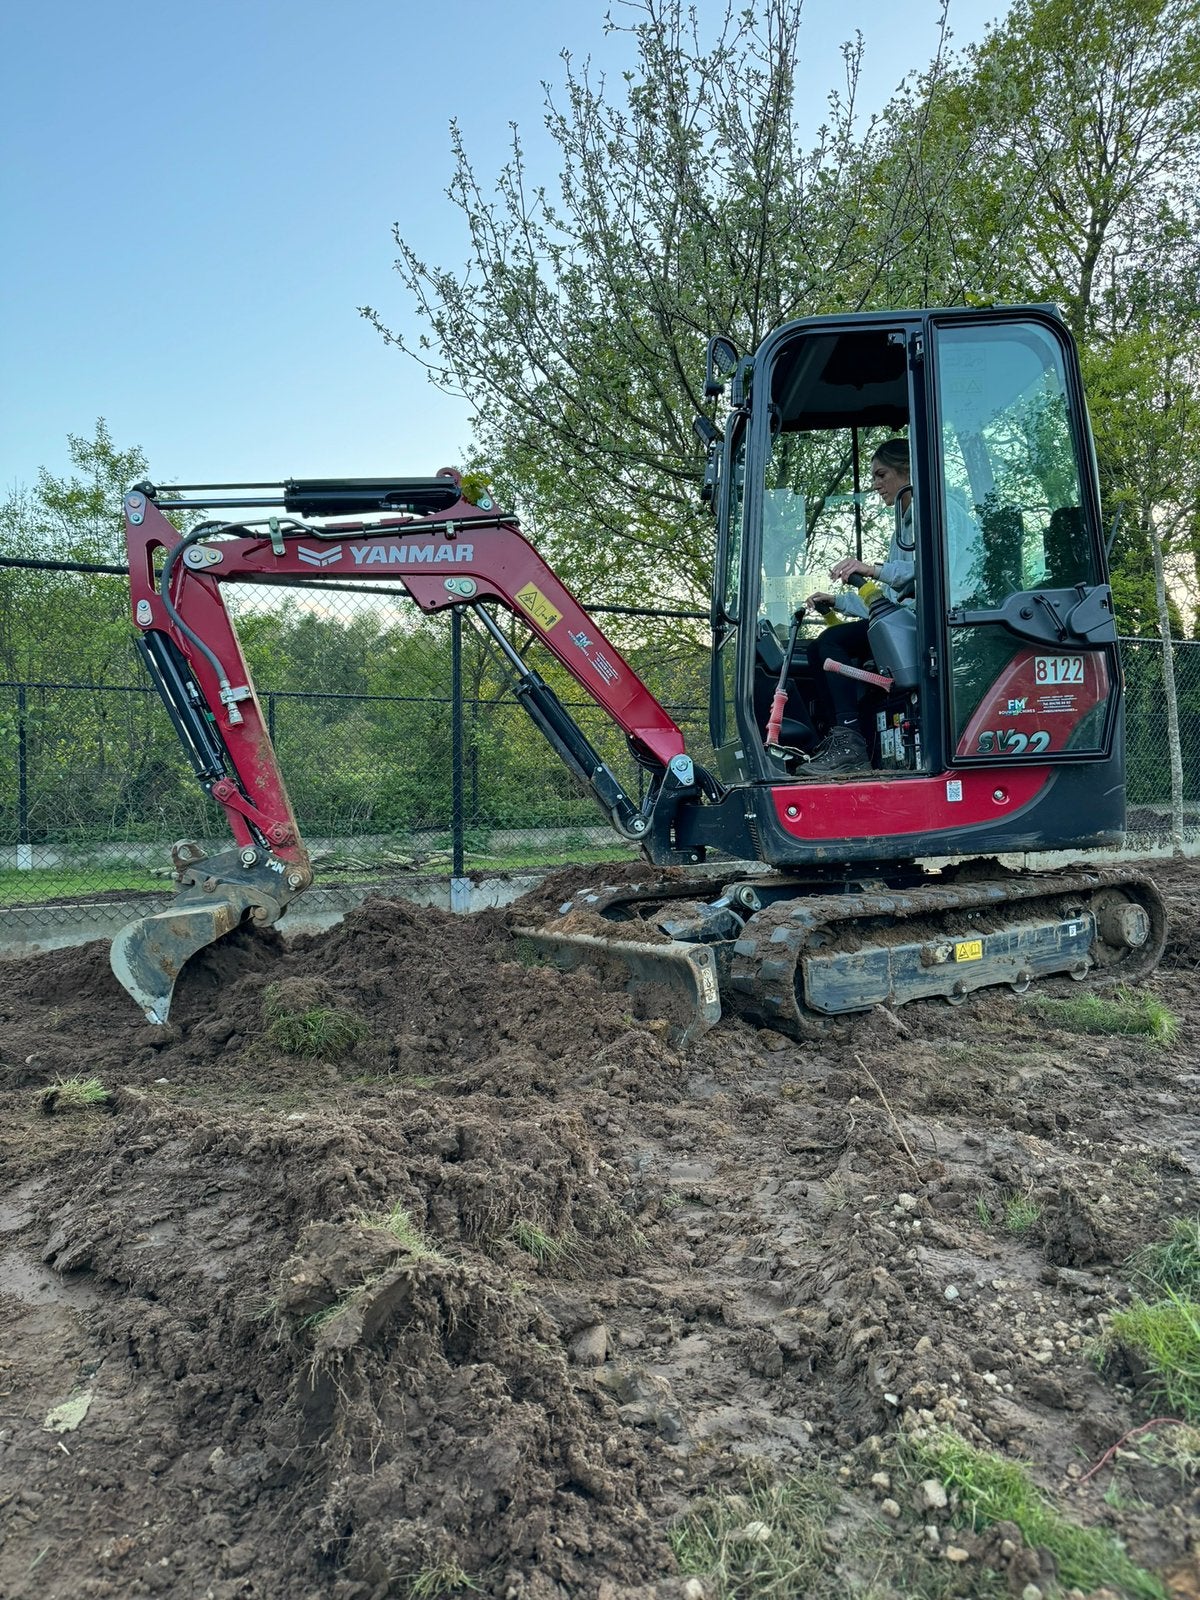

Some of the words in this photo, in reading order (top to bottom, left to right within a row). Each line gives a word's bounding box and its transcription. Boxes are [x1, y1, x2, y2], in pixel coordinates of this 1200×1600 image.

[350, 544, 474, 565] YANMAR
[1036, 658, 1083, 682] 8122
[1007, 698, 1026, 710] FM
[977, 728, 1051, 753] SV22
